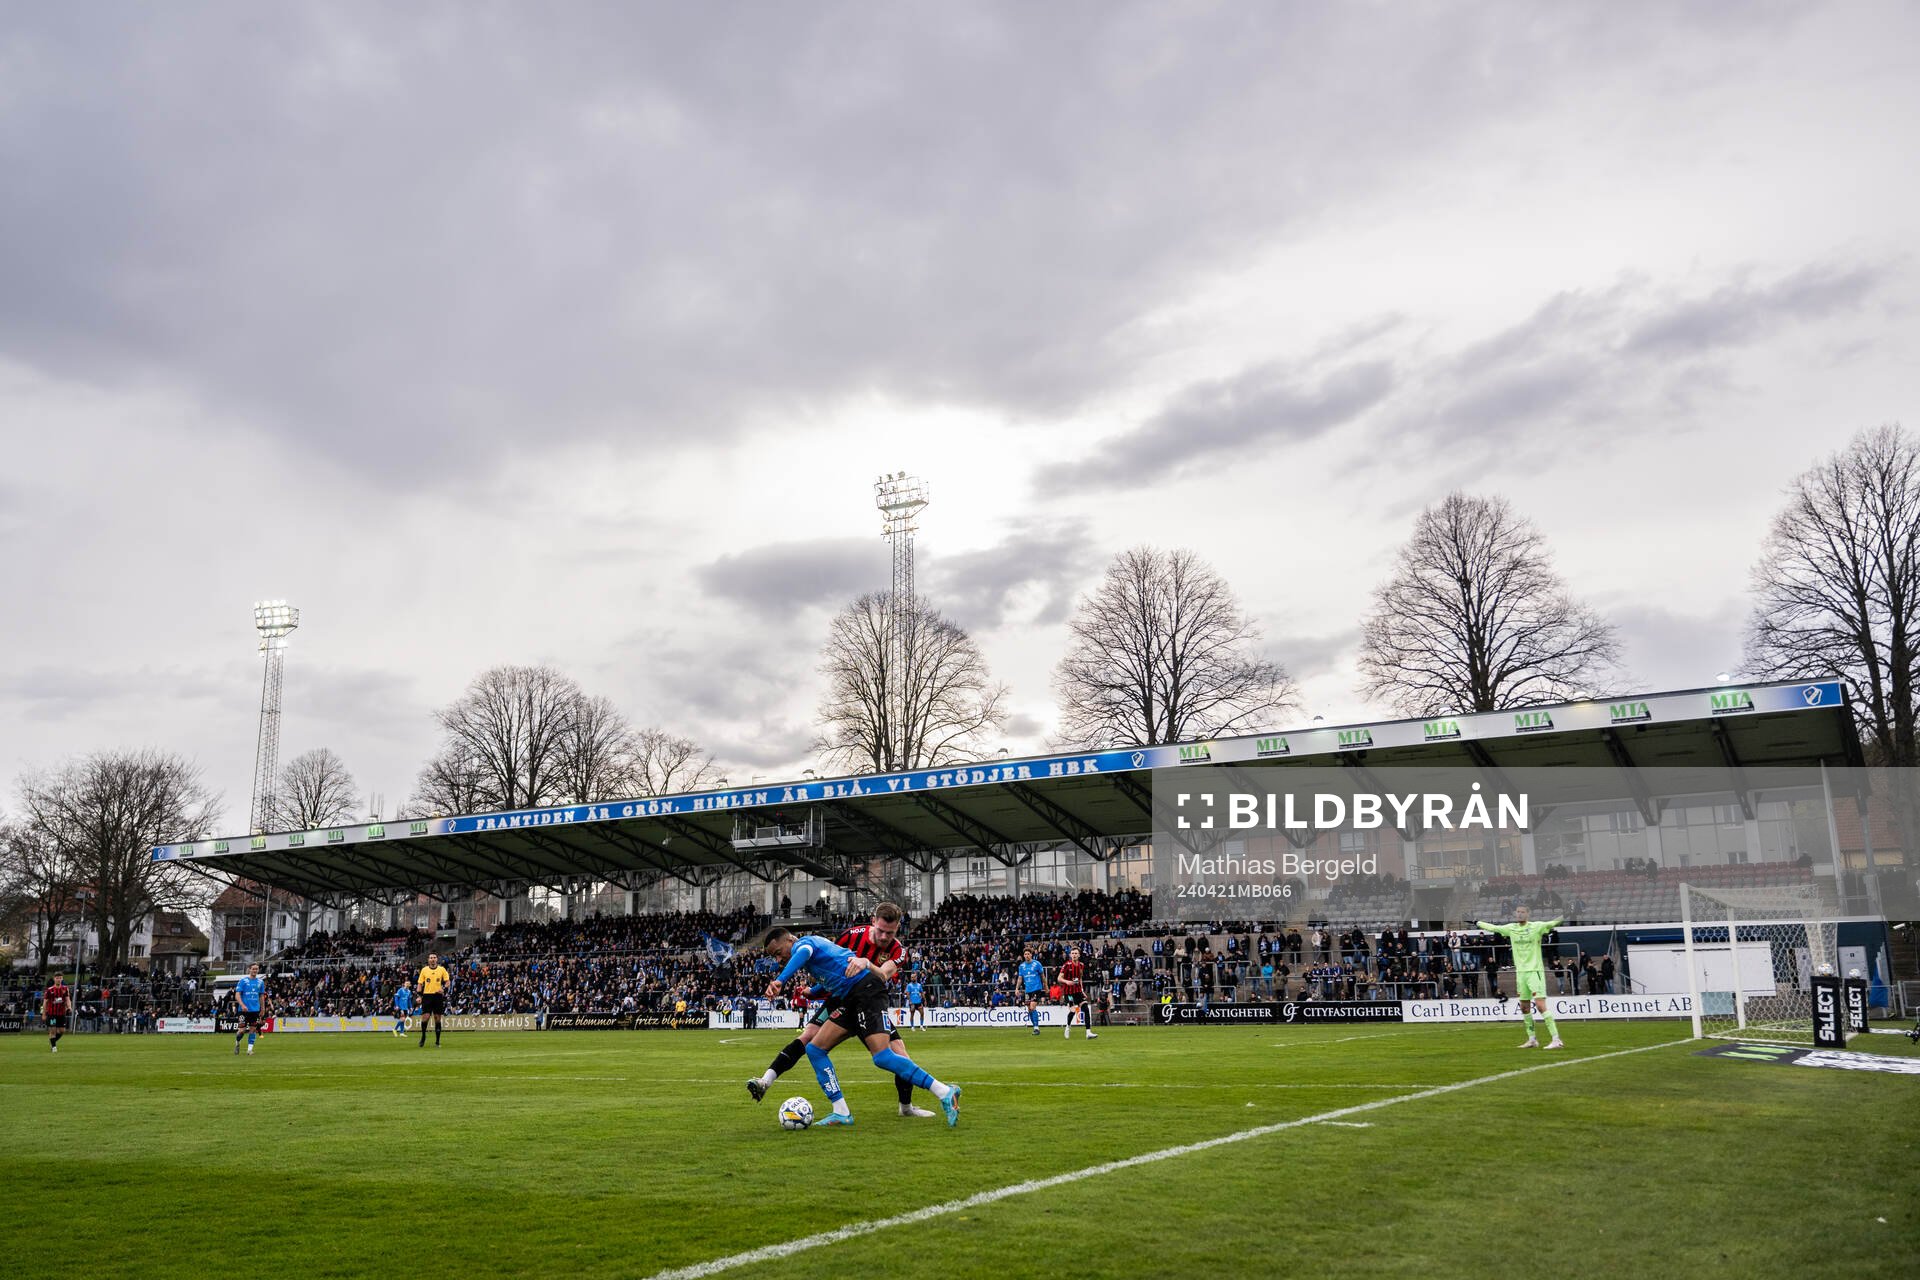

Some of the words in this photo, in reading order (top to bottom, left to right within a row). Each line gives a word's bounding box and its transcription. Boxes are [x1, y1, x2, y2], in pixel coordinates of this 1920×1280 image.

[1710, 692, 1754, 709] MTA
[1610, 702, 1651, 718] MTA
[1514, 711, 1554, 727] MTA
[1424, 721, 1461, 737] MTA
[1256, 737, 1290, 753] MTA
[1338, 729, 1374, 746] MTA
[1179, 744, 1211, 761] MTA
[476, 810, 576, 830] FRAMTIDEN
[587, 806, 610, 821] ÄR
[622, 801, 680, 817] GRÖN,
[693, 791, 767, 811] HIMLEN
[782, 787, 809, 803] ÄR
[824, 780, 871, 798] BLÅ,
[887, 777, 911, 792] VI
[926, 765, 1032, 788] STÖDJER
[1049, 759, 1099, 776] HBK
[1180, 1007, 1272, 1018] CITASTIGHETER
[1303, 1006, 1402, 1018] CITYFASTIGHETER
[1411, 1003, 1444, 1018] Carl
[1450, 1003, 1508, 1017] Bennet
[1556, 999, 1592, 1014] Carl
[1599, 998, 1661, 1014] Bennet
[1668, 996, 1693, 1012] AB
[1849, 986, 1863, 1028] SELECT
[634, 1014, 660, 1029] fritz
[928, 1008, 1050, 1025] TransportCentraen
[1817, 985, 1835, 1042] SELECT
[415, 1017, 476, 1028] HLSTADS
[480, 1017, 530, 1028] STENHUS
[550, 1015, 573, 1029] fritz
[575, 1015, 617, 1026] blommor
